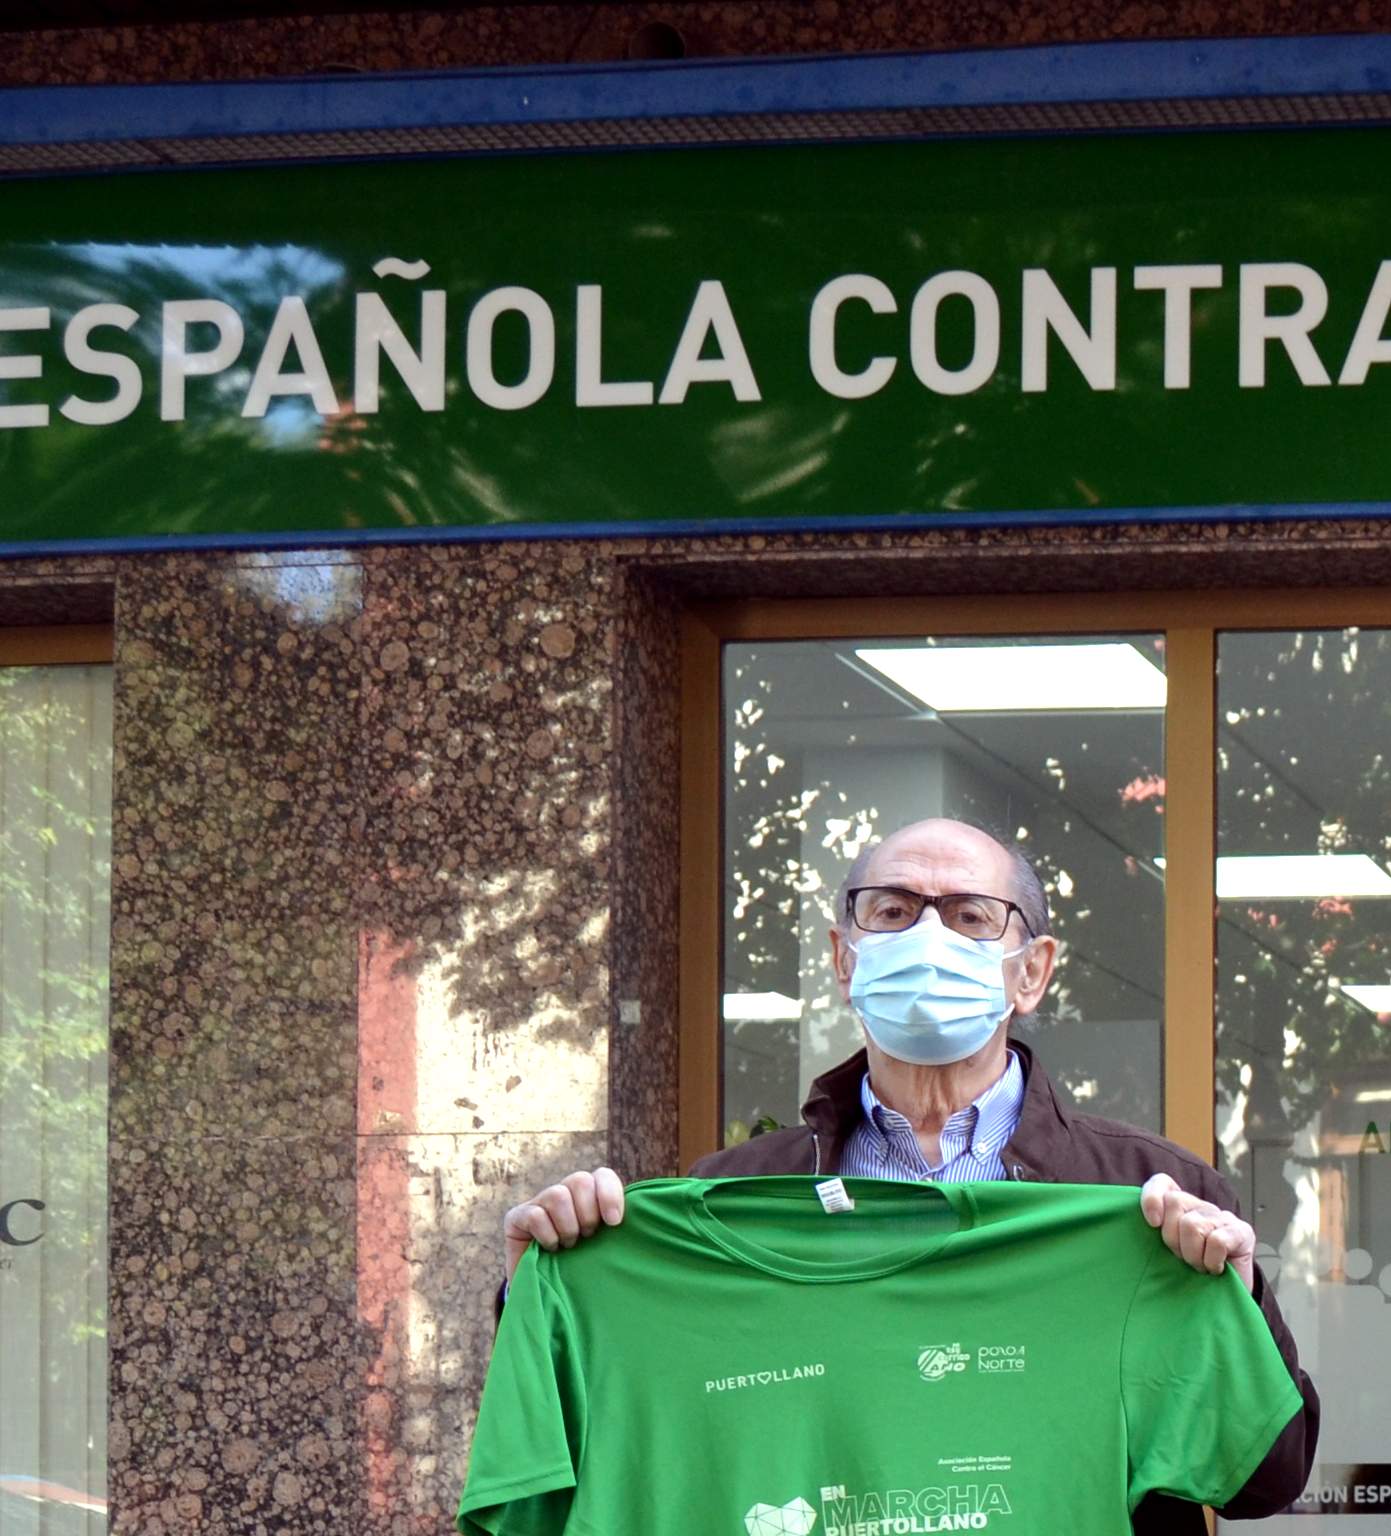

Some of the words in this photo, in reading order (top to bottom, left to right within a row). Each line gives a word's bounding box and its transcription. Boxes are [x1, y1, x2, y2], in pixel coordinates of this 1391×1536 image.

[0, 257, 762, 428] ESPAÑOLA
[819, 1484, 846, 1502] EN
[821, 1483, 1012, 1528] MARCHA
[1296, 1482, 1348, 1504] CIÓN
